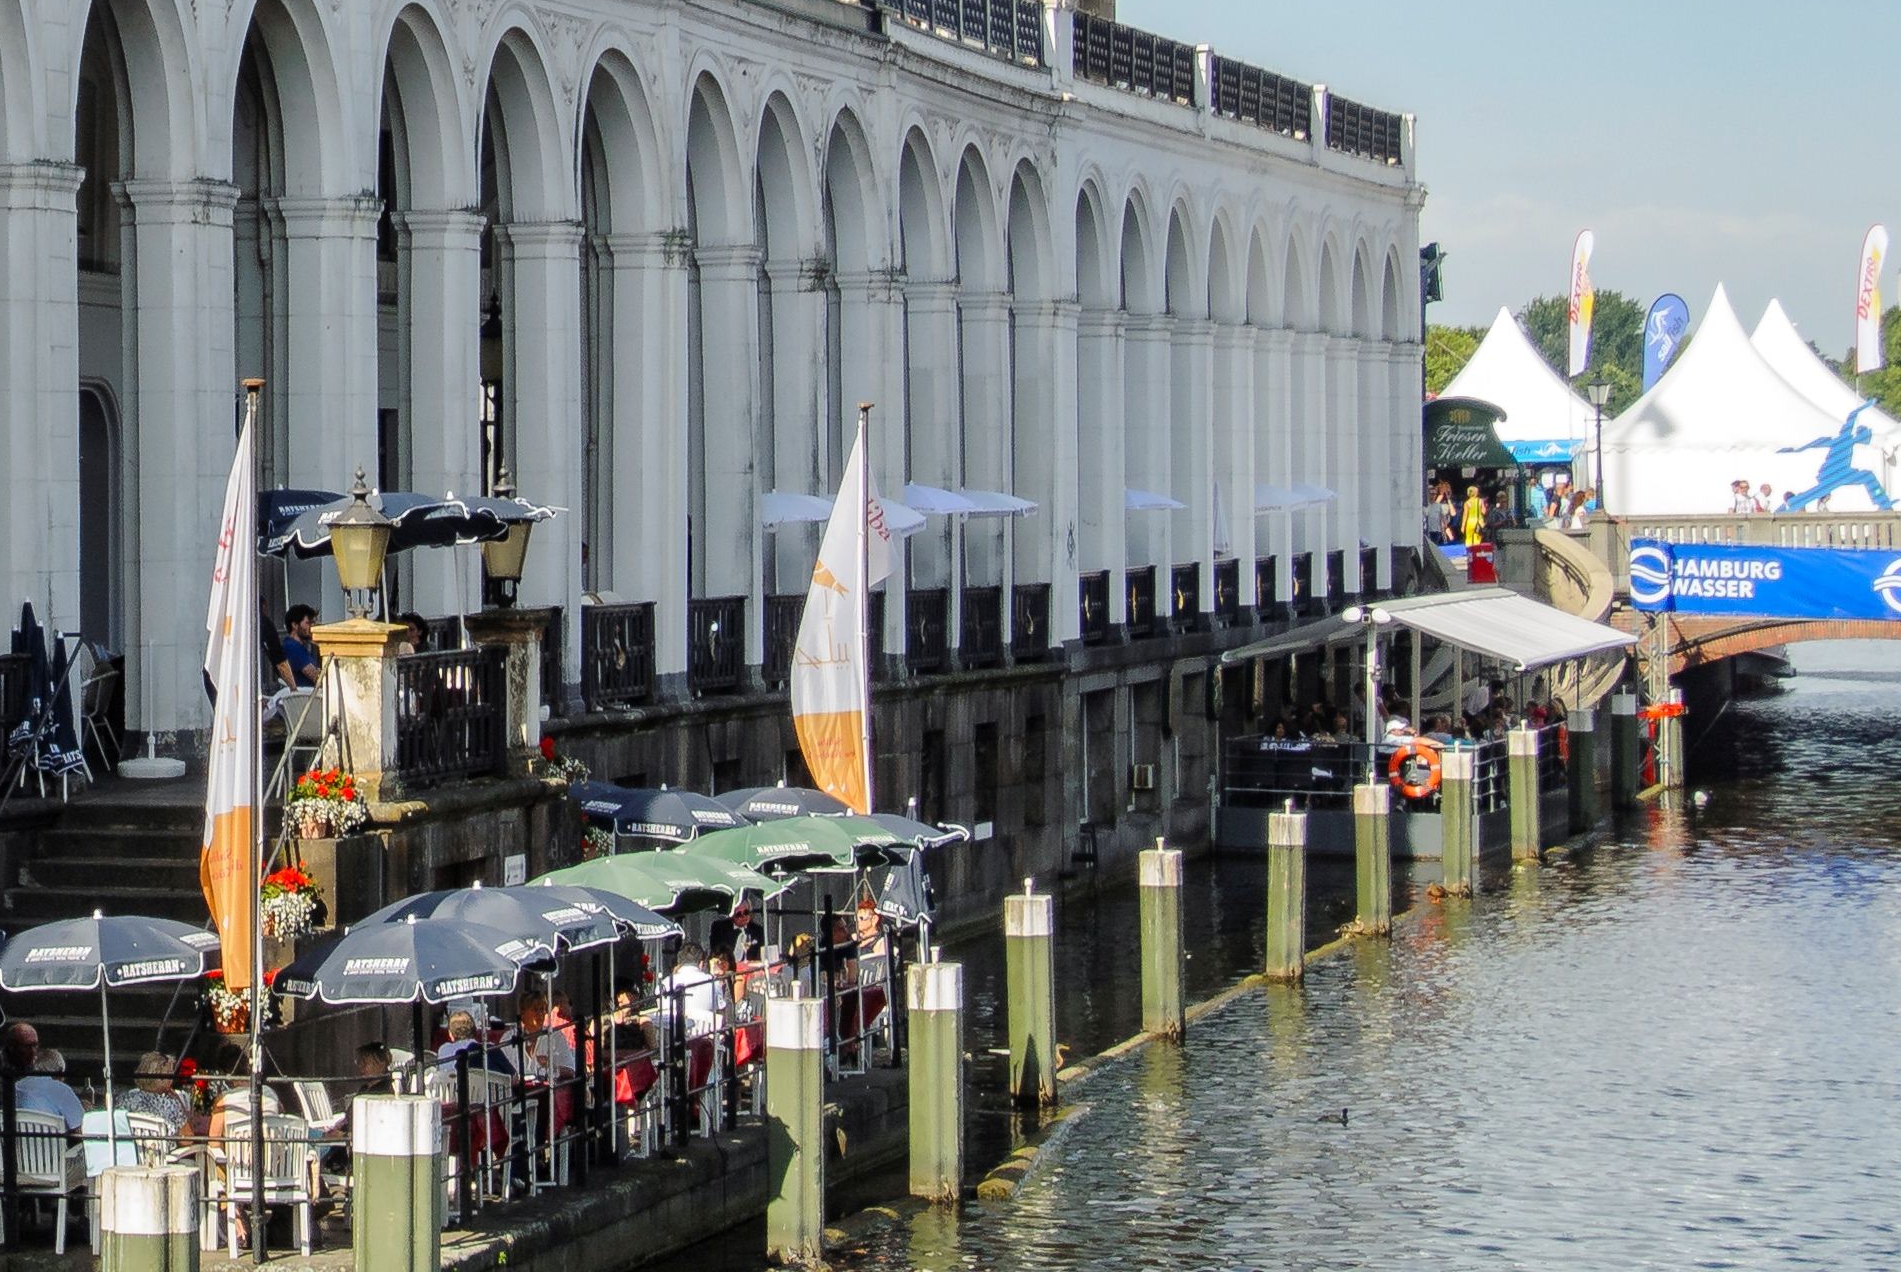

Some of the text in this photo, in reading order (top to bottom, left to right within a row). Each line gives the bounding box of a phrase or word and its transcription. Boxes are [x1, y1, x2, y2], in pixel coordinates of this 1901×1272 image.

[1569, 262, 1583, 326] DEXTRO
[1857, 257, 1876, 321] DEXTRO
[1433, 443, 1488, 460] Keller
[1672, 559, 1782, 580] HAMBURG
[1673, 578, 1754, 599] WASSER
[122, 958, 180, 978] RATSHERRN
[344, 957, 410, 969] RATSHERRN
[440, 975, 494, 996] RATSHERRN
